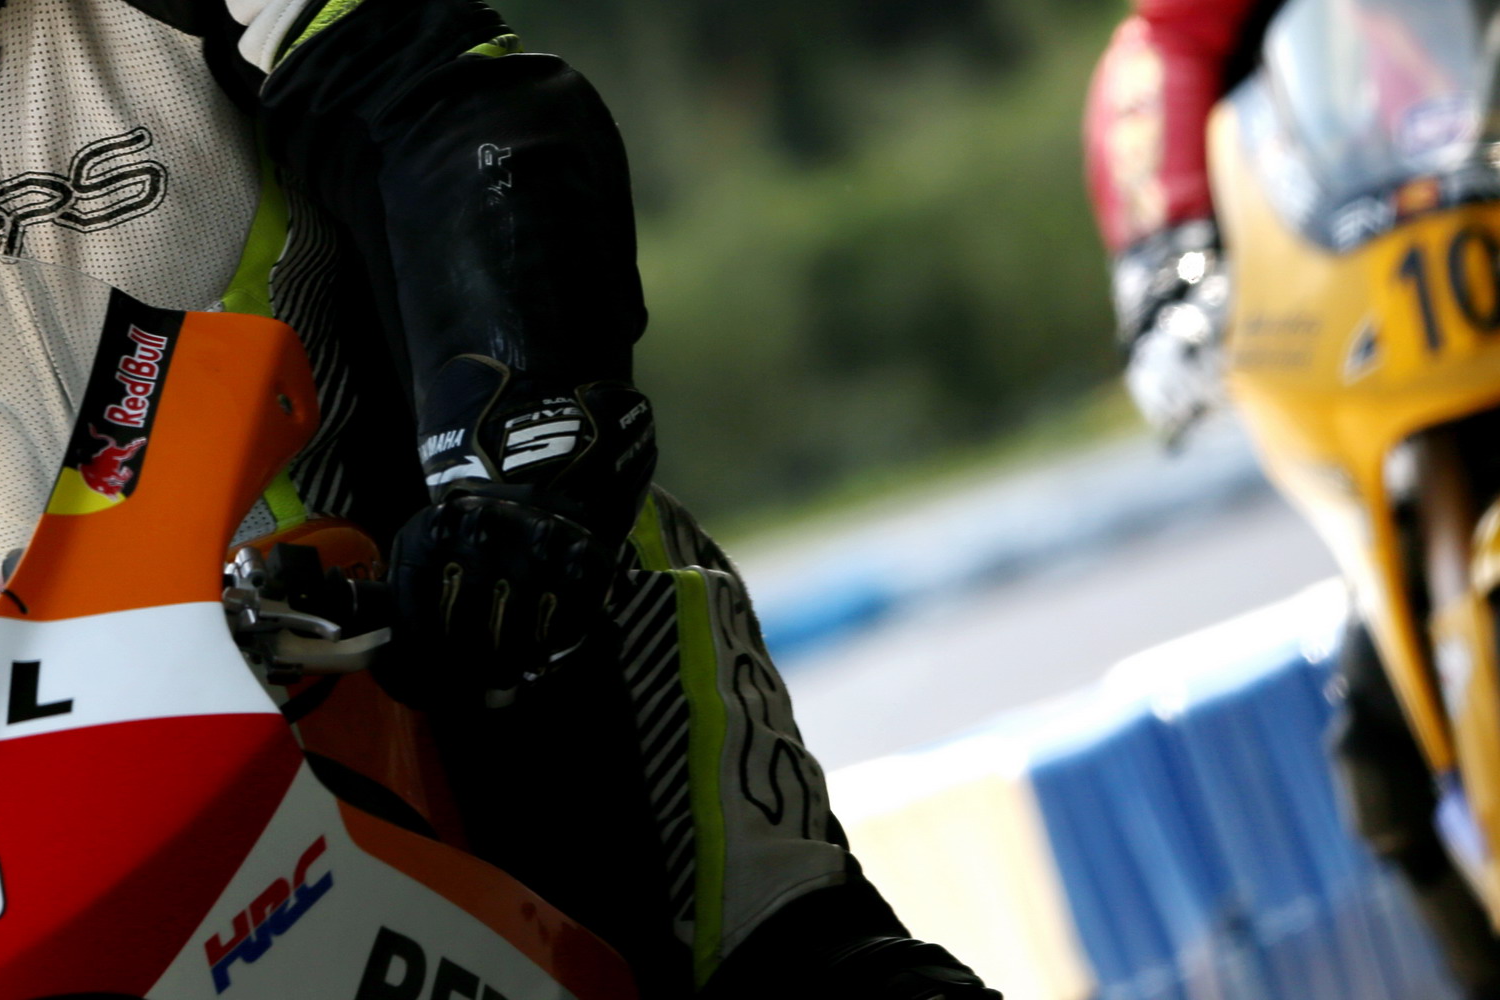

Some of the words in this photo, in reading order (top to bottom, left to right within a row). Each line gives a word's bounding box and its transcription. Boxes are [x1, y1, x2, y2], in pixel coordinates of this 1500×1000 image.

[118, 323, 169, 380] Bull
[103, 371, 156, 428] Red
[203, 833, 334, 996] HRC
